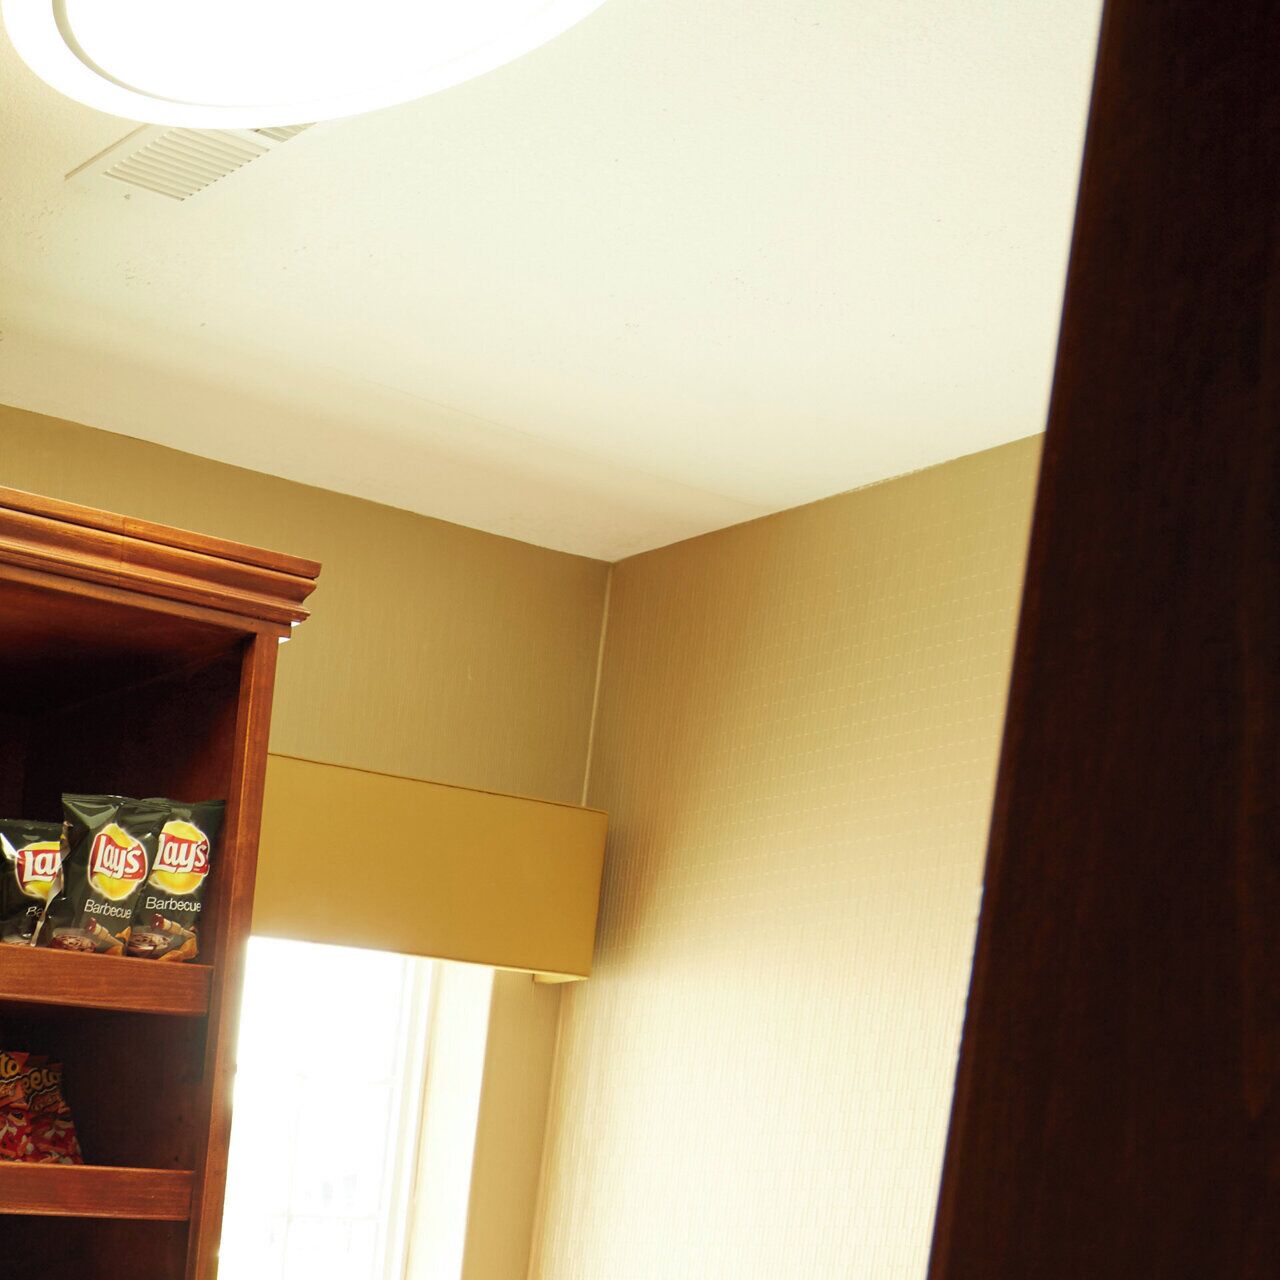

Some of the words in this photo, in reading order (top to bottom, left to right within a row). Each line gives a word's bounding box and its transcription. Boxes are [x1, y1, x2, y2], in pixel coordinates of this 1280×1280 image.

[92, 834, 143, 879] Lay's
[155, 832, 208, 874] Lay's
[84, 900, 133, 919] Barbecue
[145, 897, 202, 912] Barbecue
